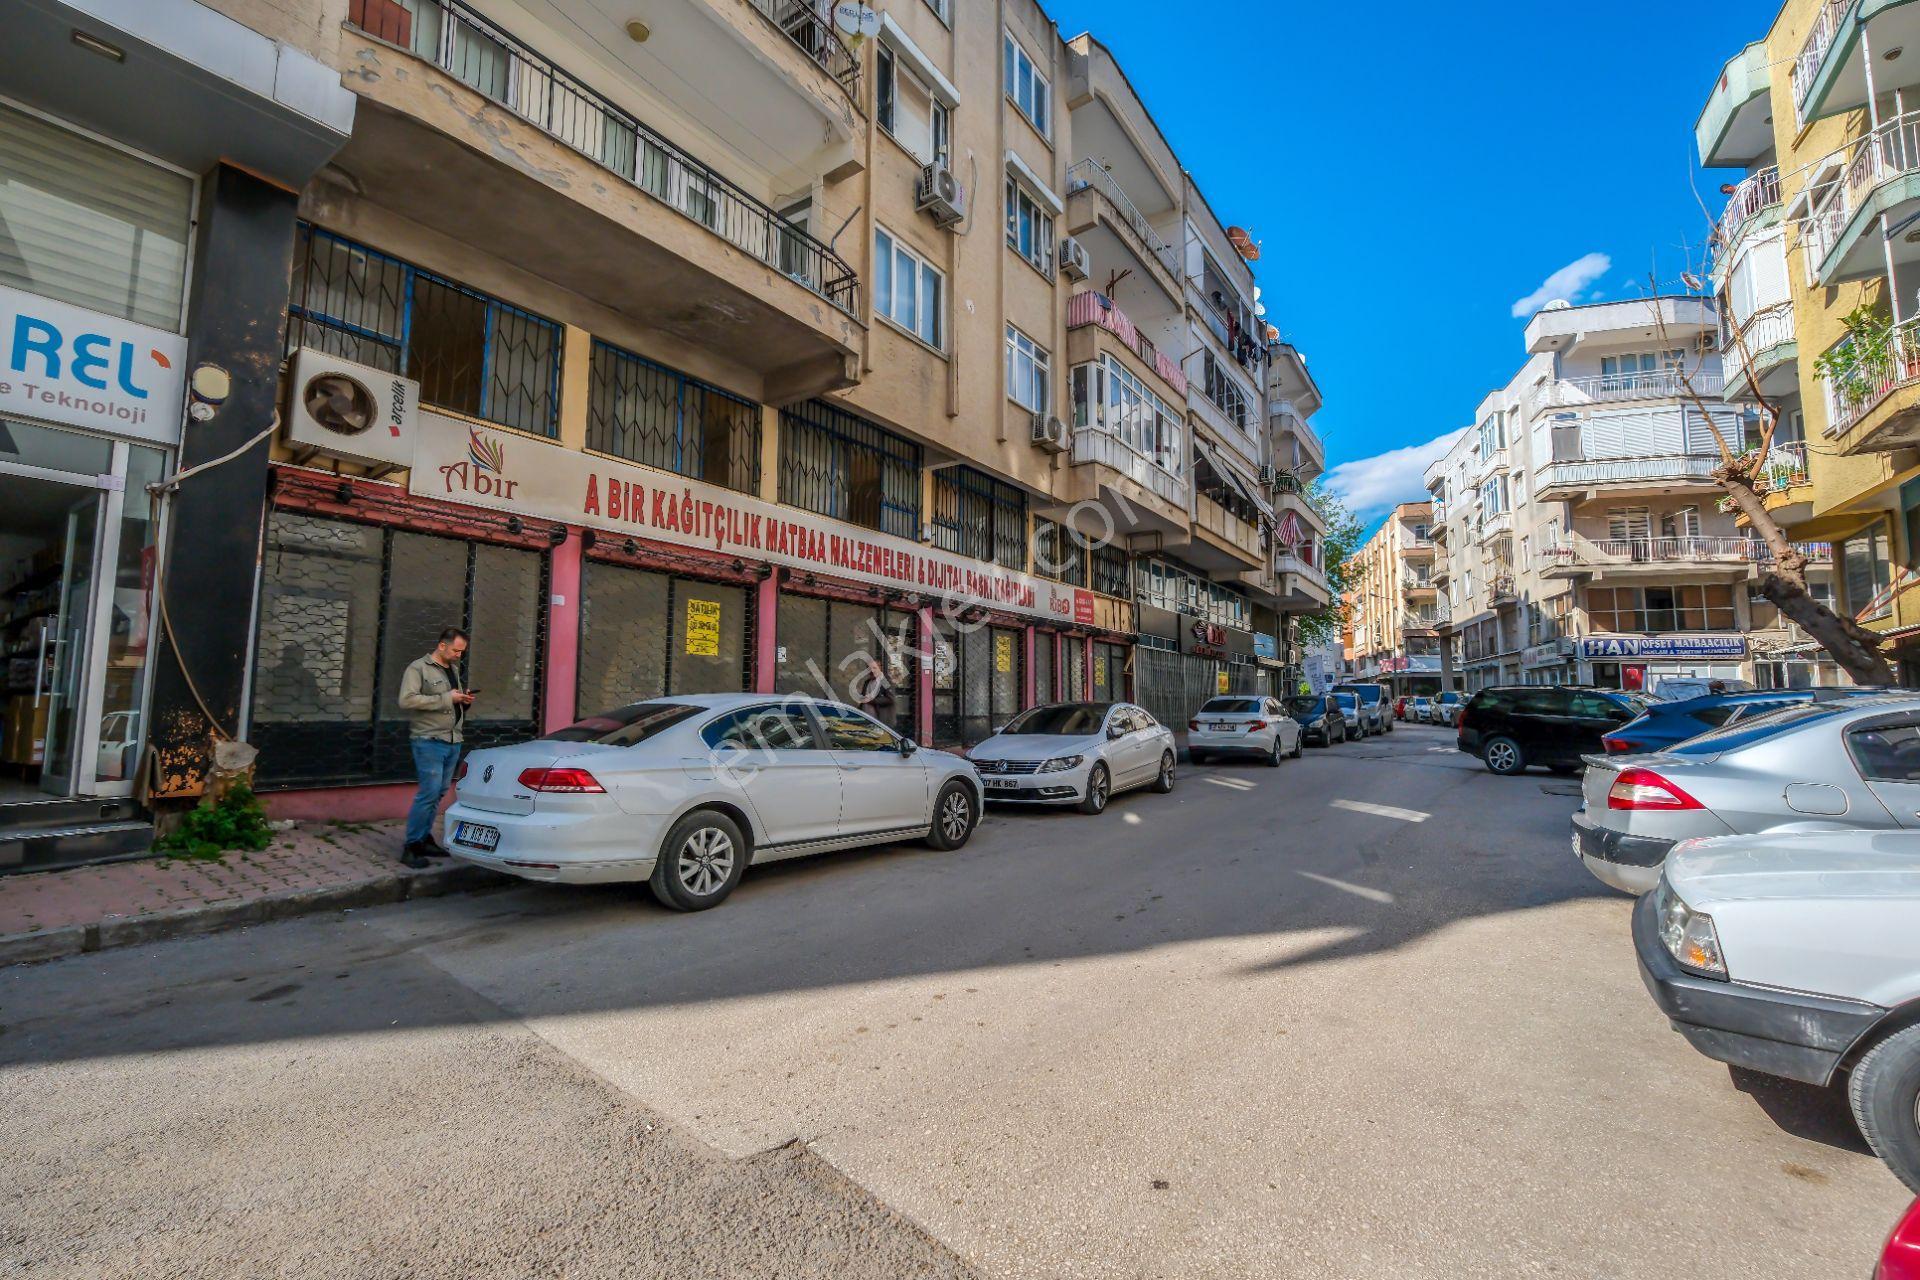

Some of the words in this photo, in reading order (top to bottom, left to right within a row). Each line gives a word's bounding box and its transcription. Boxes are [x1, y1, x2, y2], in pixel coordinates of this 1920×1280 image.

[23, 383, 147, 424] Teknoloji
[391, 380, 406, 425] arçelik
[583, 473, 600, 516] A
[651, 487, 762, 550] KAĞITÇILIK
[765, 517, 827, 564] MATBAA
[917, 556, 925, 585] &
[966, 568, 993, 600] BASKI
[1588, 638, 1639, 656] HAN
[1641, 638, 1672, 649] OFSET
